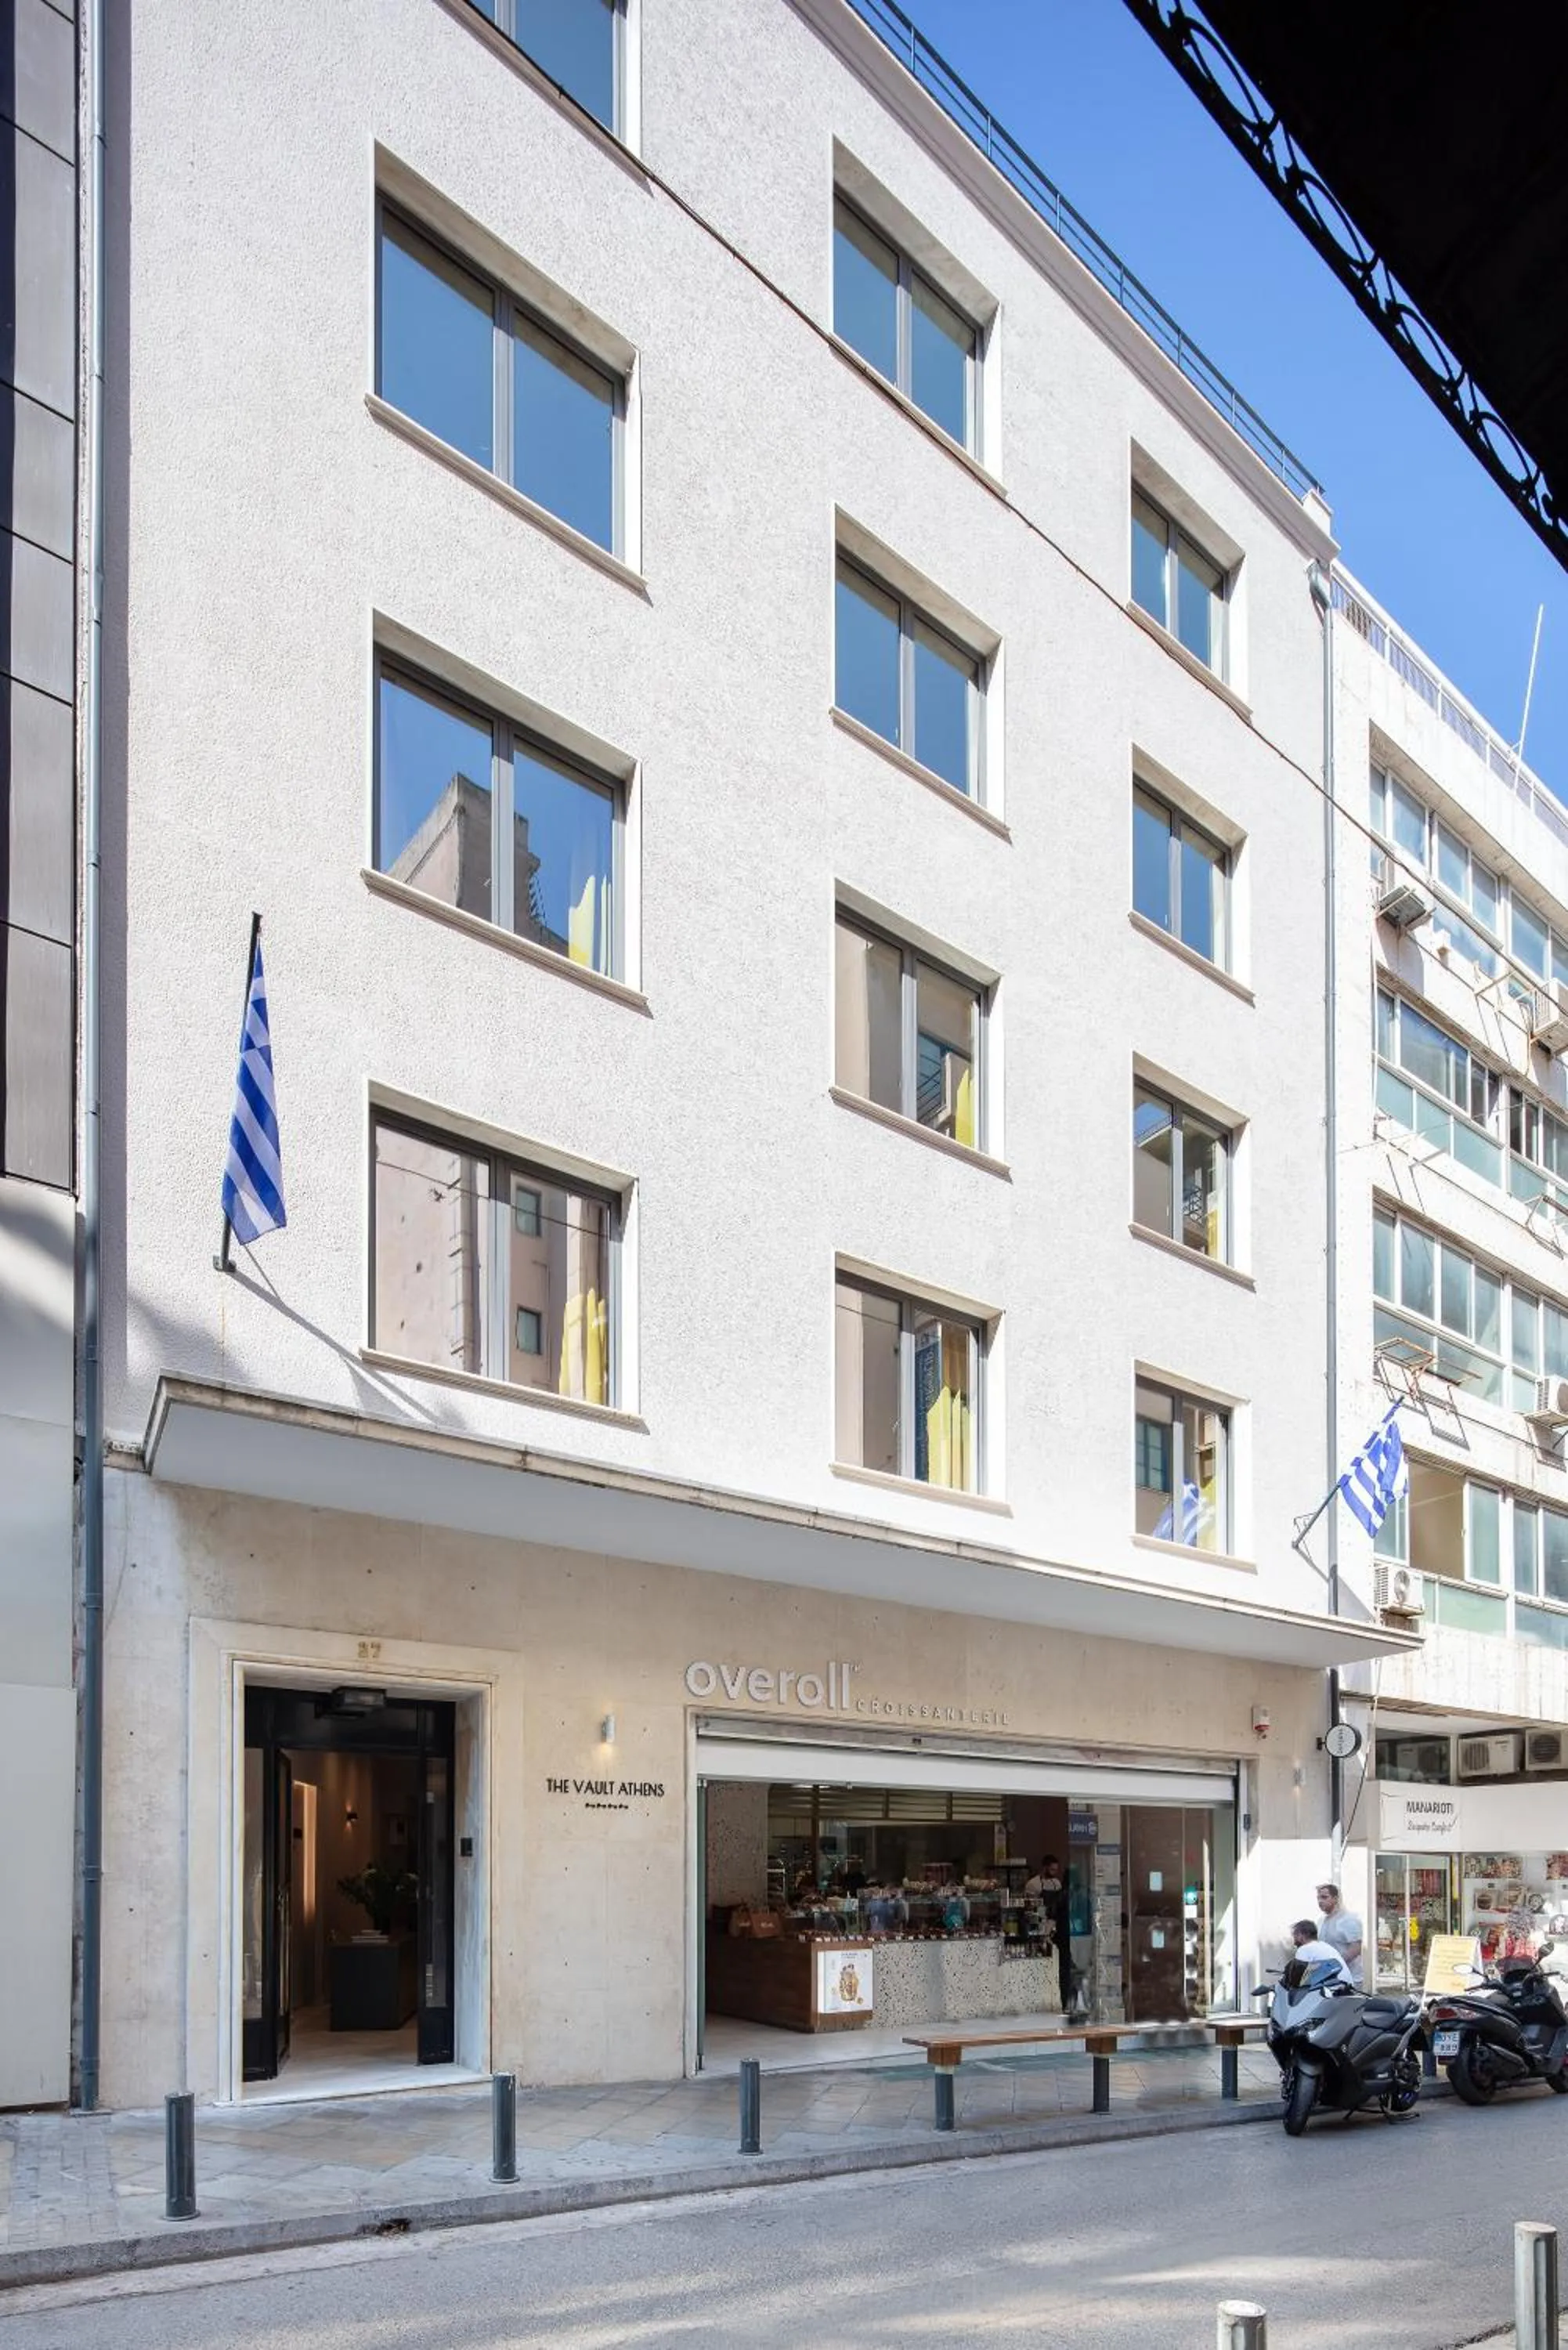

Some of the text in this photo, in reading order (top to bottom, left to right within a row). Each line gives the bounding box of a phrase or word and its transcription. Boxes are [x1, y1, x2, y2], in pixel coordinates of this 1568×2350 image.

[547, 1778, 665, 1798] THE VAULT ATHENS
